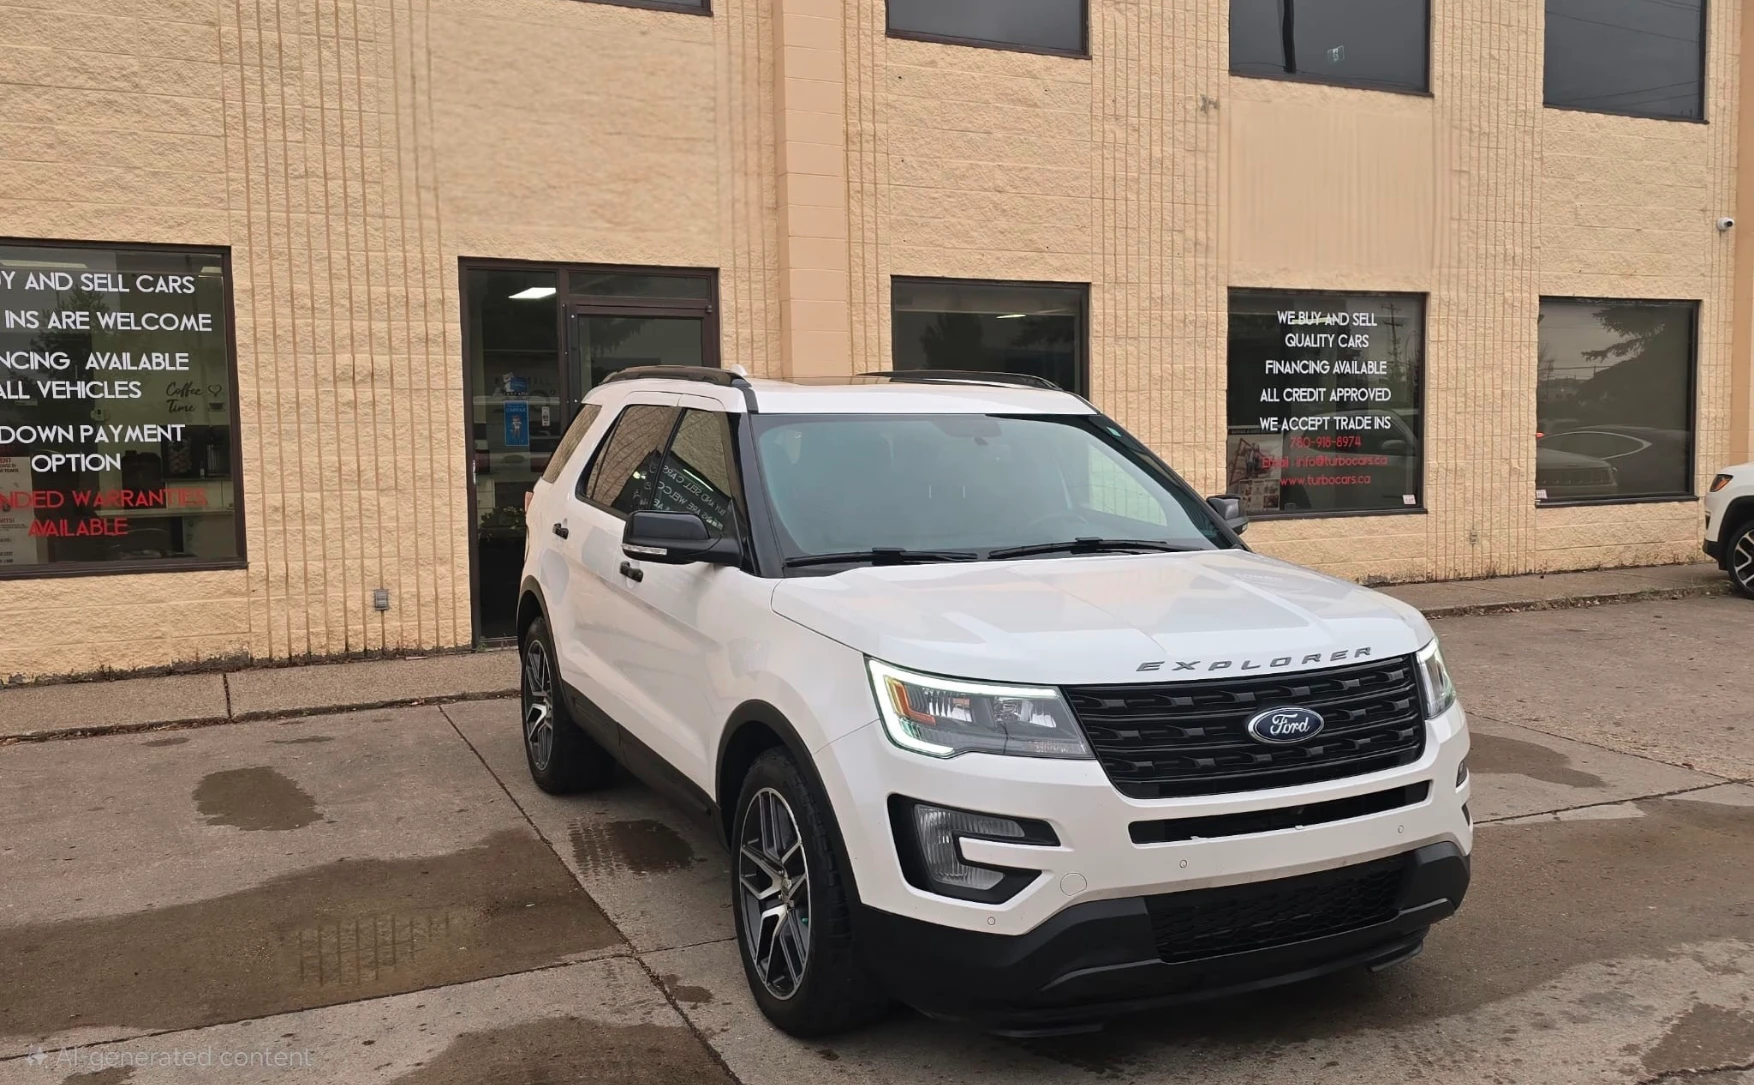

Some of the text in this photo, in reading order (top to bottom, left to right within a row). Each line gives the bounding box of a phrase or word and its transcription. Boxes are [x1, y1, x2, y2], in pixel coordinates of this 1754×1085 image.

[0, 271, 195, 294] Y AND SELL CARS
[5, 310, 212, 332] INS ARE WELCOME
[1277, 311, 1377, 327] WE BUY AND SELL
[1285, 333, 1369, 348] QUALITY CARS
[85, 353, 189, 371] AVAILABLE
[1265, 360, 1387, 375] FINANCING AVAILABLE
[37, 381, 142, 400] VEHICLES
[166, 381, 203, 397] Coffee
[1260, 388, 1391, 402] ALL CREDIT APPROVED
[166, 399, 196, 413] Time
[1260, 416, 1391, 431] WE ACCEPT TRADE INS
[0, 424, 185, 444] DOWN PAYMENT
[1290, 436, 1362, 449] 780-918-8974
[31, 454, 121, 473] OPTION
[1280, 475, 1371, 486] www.turbocars.ca
[72, 488, 208, 508] WARRANTIES
[28, 518, 128, 537] AVAILABLE
[1136, 647, 1371, 672] EXPLORER
[1270, 713, 1310, 736] Ford
